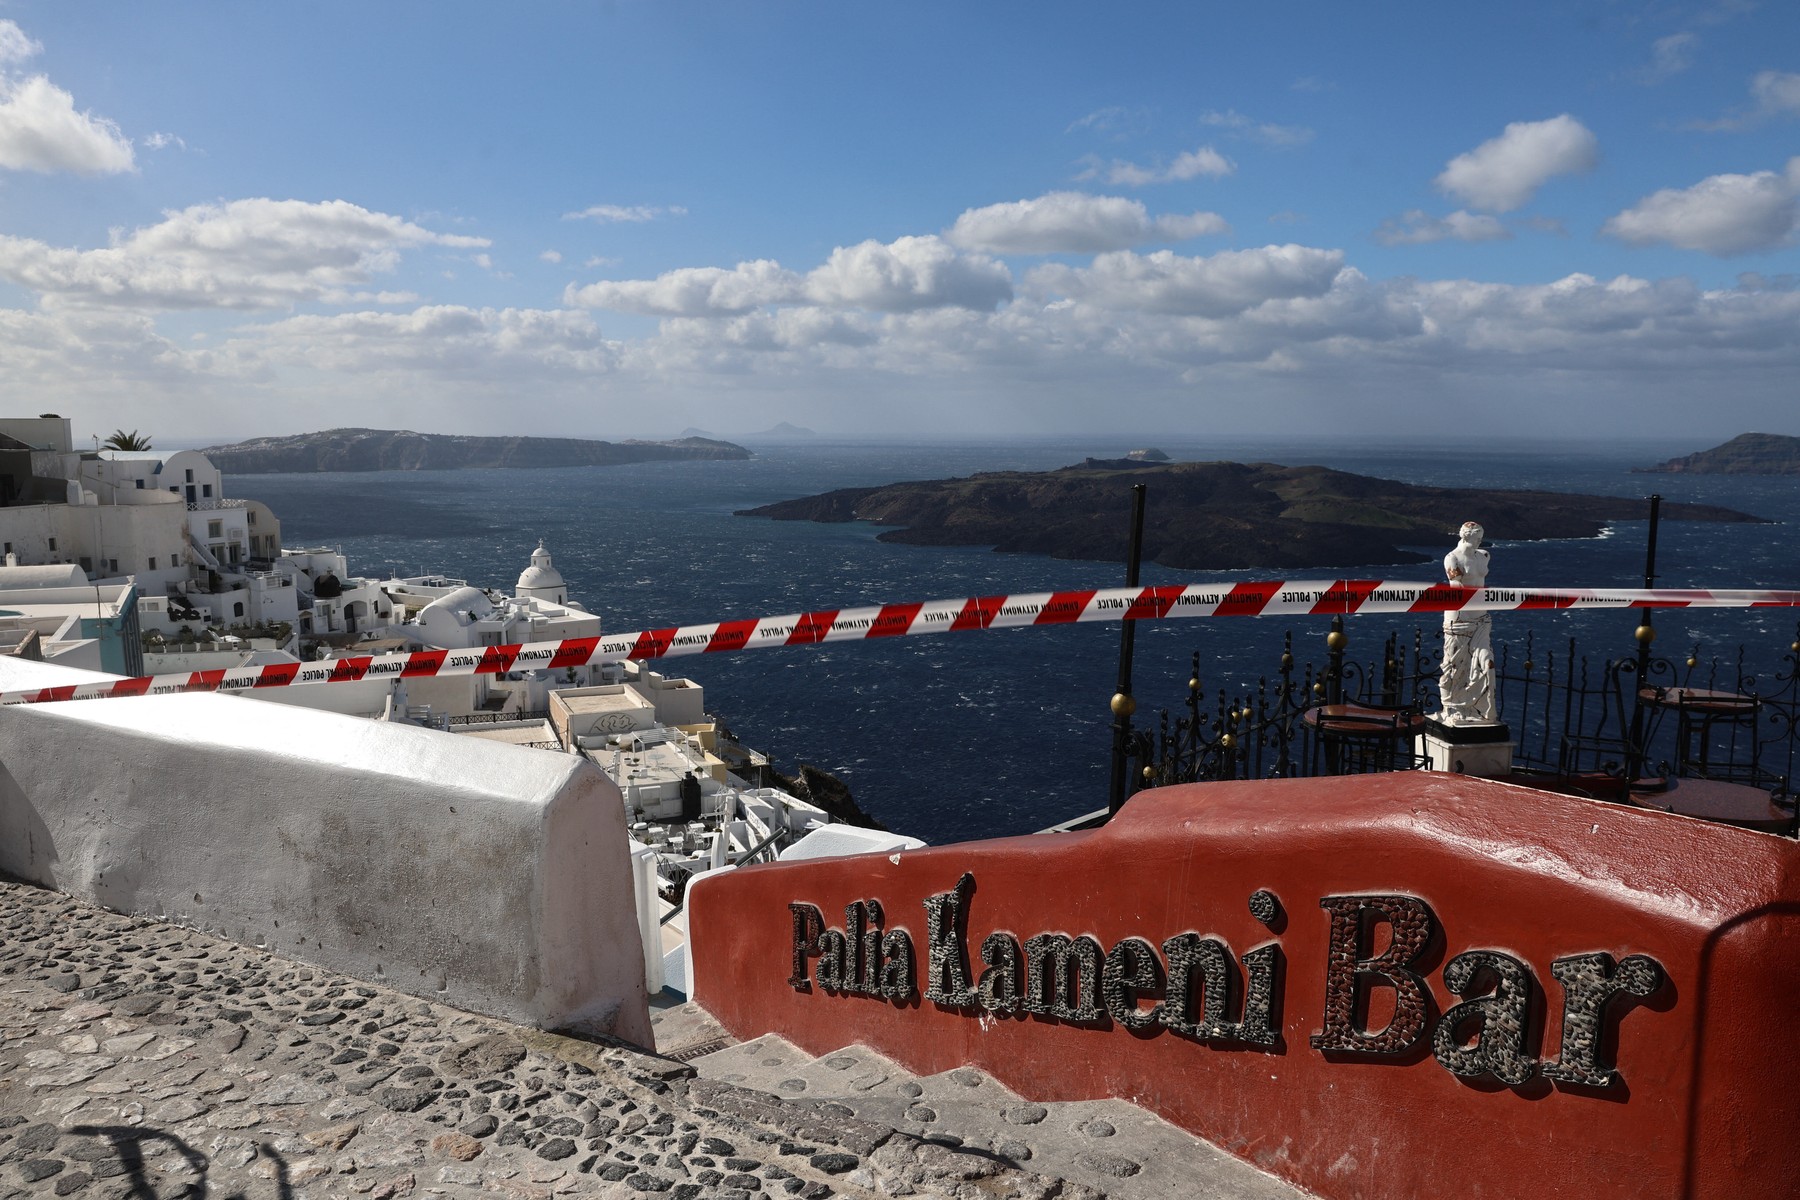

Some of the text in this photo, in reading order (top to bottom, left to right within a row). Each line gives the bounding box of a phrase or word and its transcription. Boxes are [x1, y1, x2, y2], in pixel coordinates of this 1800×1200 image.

[1282, 591, 1358, 603] MUNICIPAL POLICE
[1484, 589, 1516, 602] POLICE
[1097, 598, 1123, 609] POLICE
[924, 612, 949, 623] POLICE
[760, 626, 783, 638] POLICE
[602, 642, 626, 653] POLICE
[450, 656, 474, 667] POLICE
[302, 670, 325, 681] POLICE
[788, 870, 1663, 1087] Palia Kameni Bar
